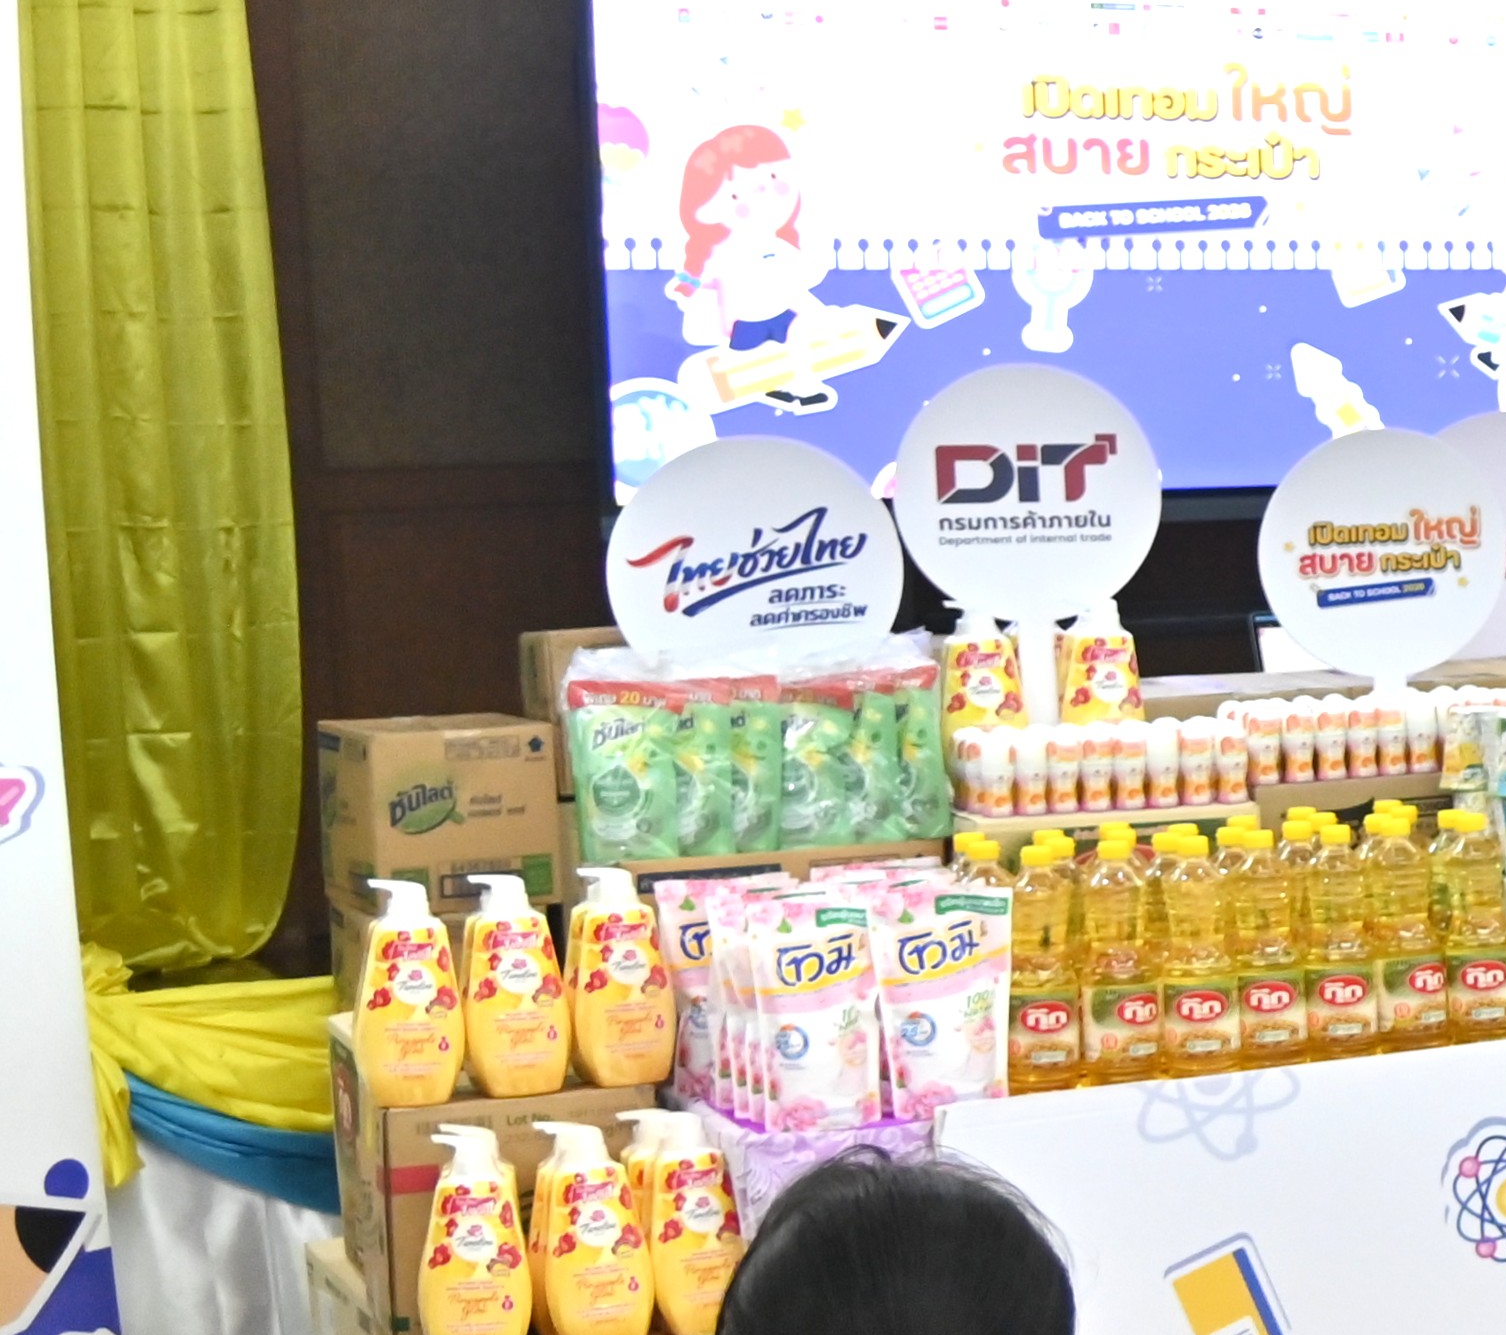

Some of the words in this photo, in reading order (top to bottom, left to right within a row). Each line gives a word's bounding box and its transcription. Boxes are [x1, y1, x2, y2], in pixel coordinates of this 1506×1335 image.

[1023, 74, 1217, 121] เปิดเทอม
[1224, 63, 1352, 135] ใหญ่
[1002, 133, 1150, 175] สบาย
[1164, 130, 1320, 179] กระเป๋า
[938, 510, 1111, 531] กรมการค้าภายใน
[1308, 521, 1408, 546] เปิดเทอม
[1409, 505, 1480, 547] ใหญ่
[938, 535, 1012, 547] Department
[626, 506, 868, 613] ไทยช่วยไทย
[1299, 551, 1375, 578] สบาย
[768, 584, 846, 604] ลดภาระ
[750, 603, 867, 626] ลดค่าครองชีพ
[620, 691, 640, 704] 20
